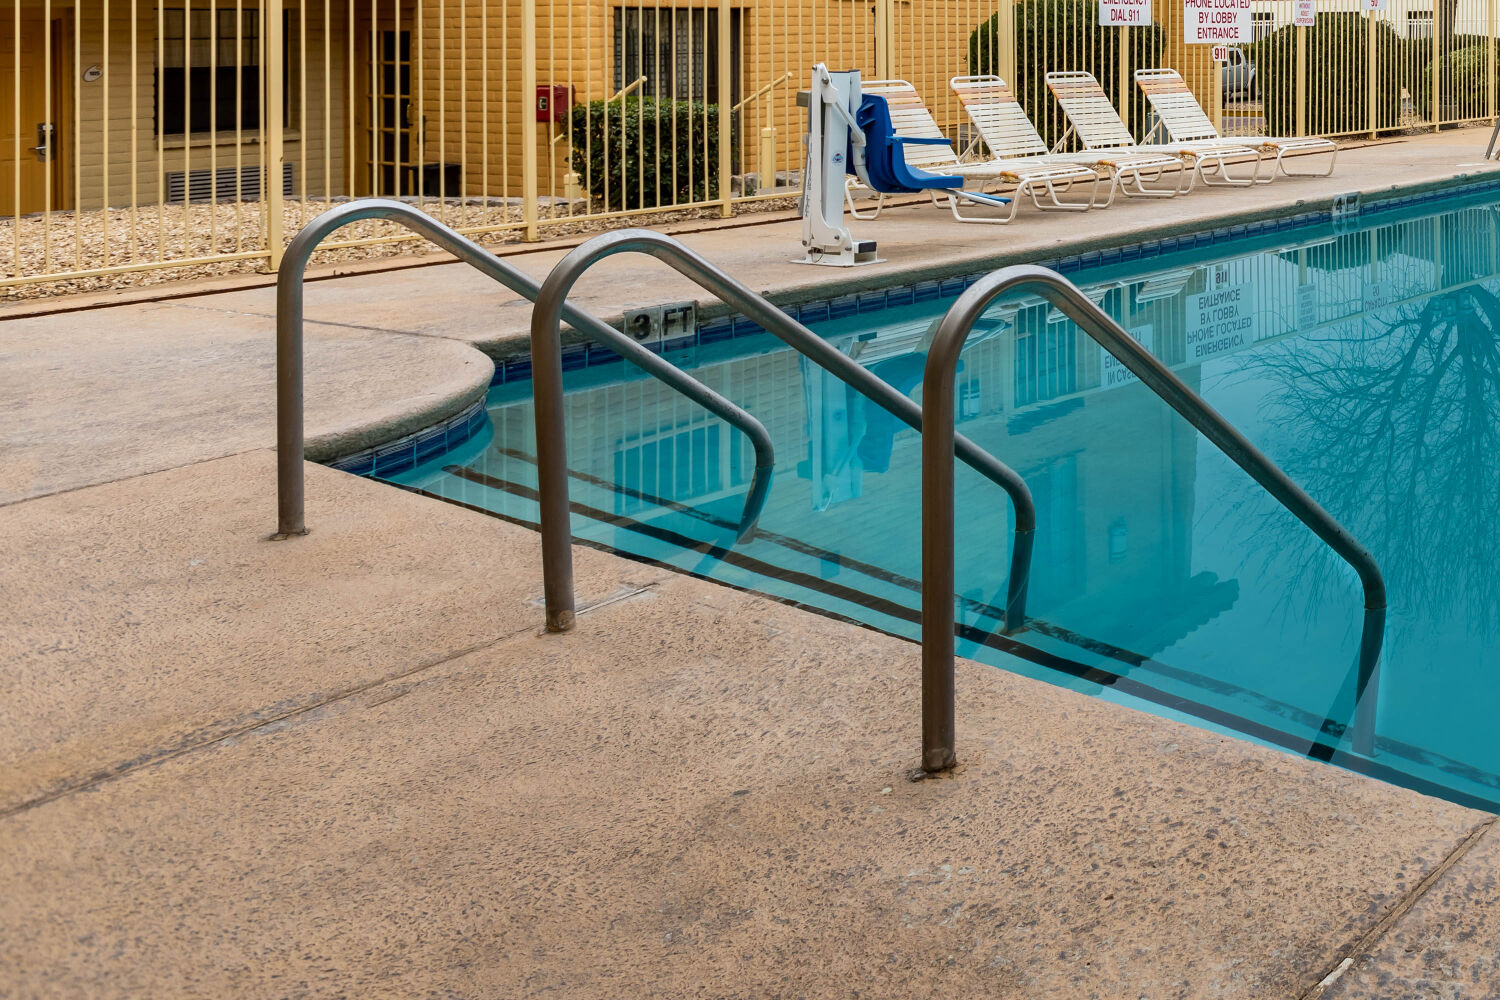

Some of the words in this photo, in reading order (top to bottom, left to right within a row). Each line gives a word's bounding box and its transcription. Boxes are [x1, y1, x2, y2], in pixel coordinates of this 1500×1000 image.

[1110, 8, 1127, 21] DIAL
[1128, 9, 1140, 22] 911
[1198, 12, 1210, 24] BY
[1211, 11, 1238, 24] LOBBY
[1197, 27, 1240, 39] ENTRANCE
[1214, 48, 1226, 60] 911
[632, 313, 651, 340] 3
[663, 306, 693, 336] FT
